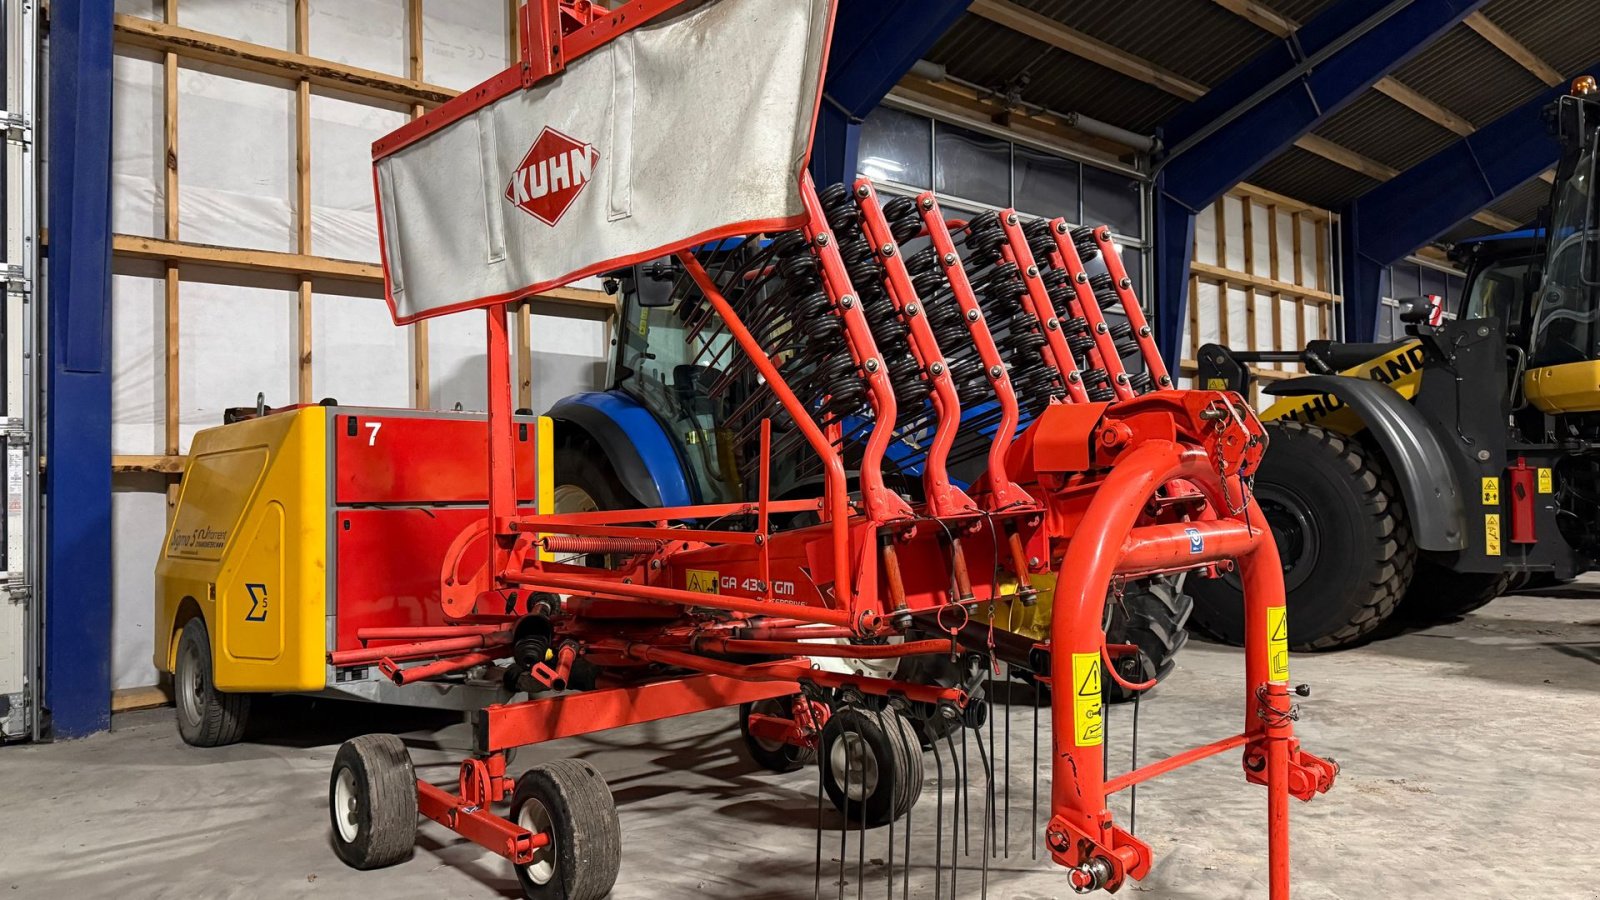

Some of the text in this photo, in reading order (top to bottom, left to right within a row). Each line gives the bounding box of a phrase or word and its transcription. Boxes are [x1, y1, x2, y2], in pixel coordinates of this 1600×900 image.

[512, 143, 592, 207] KUHN
[1302, 344, 1425, 423] HOAND
[364, 421, 382, 447] 7
[720, 576, 737, 589] GA
[774, 581, 795, 595] GM
